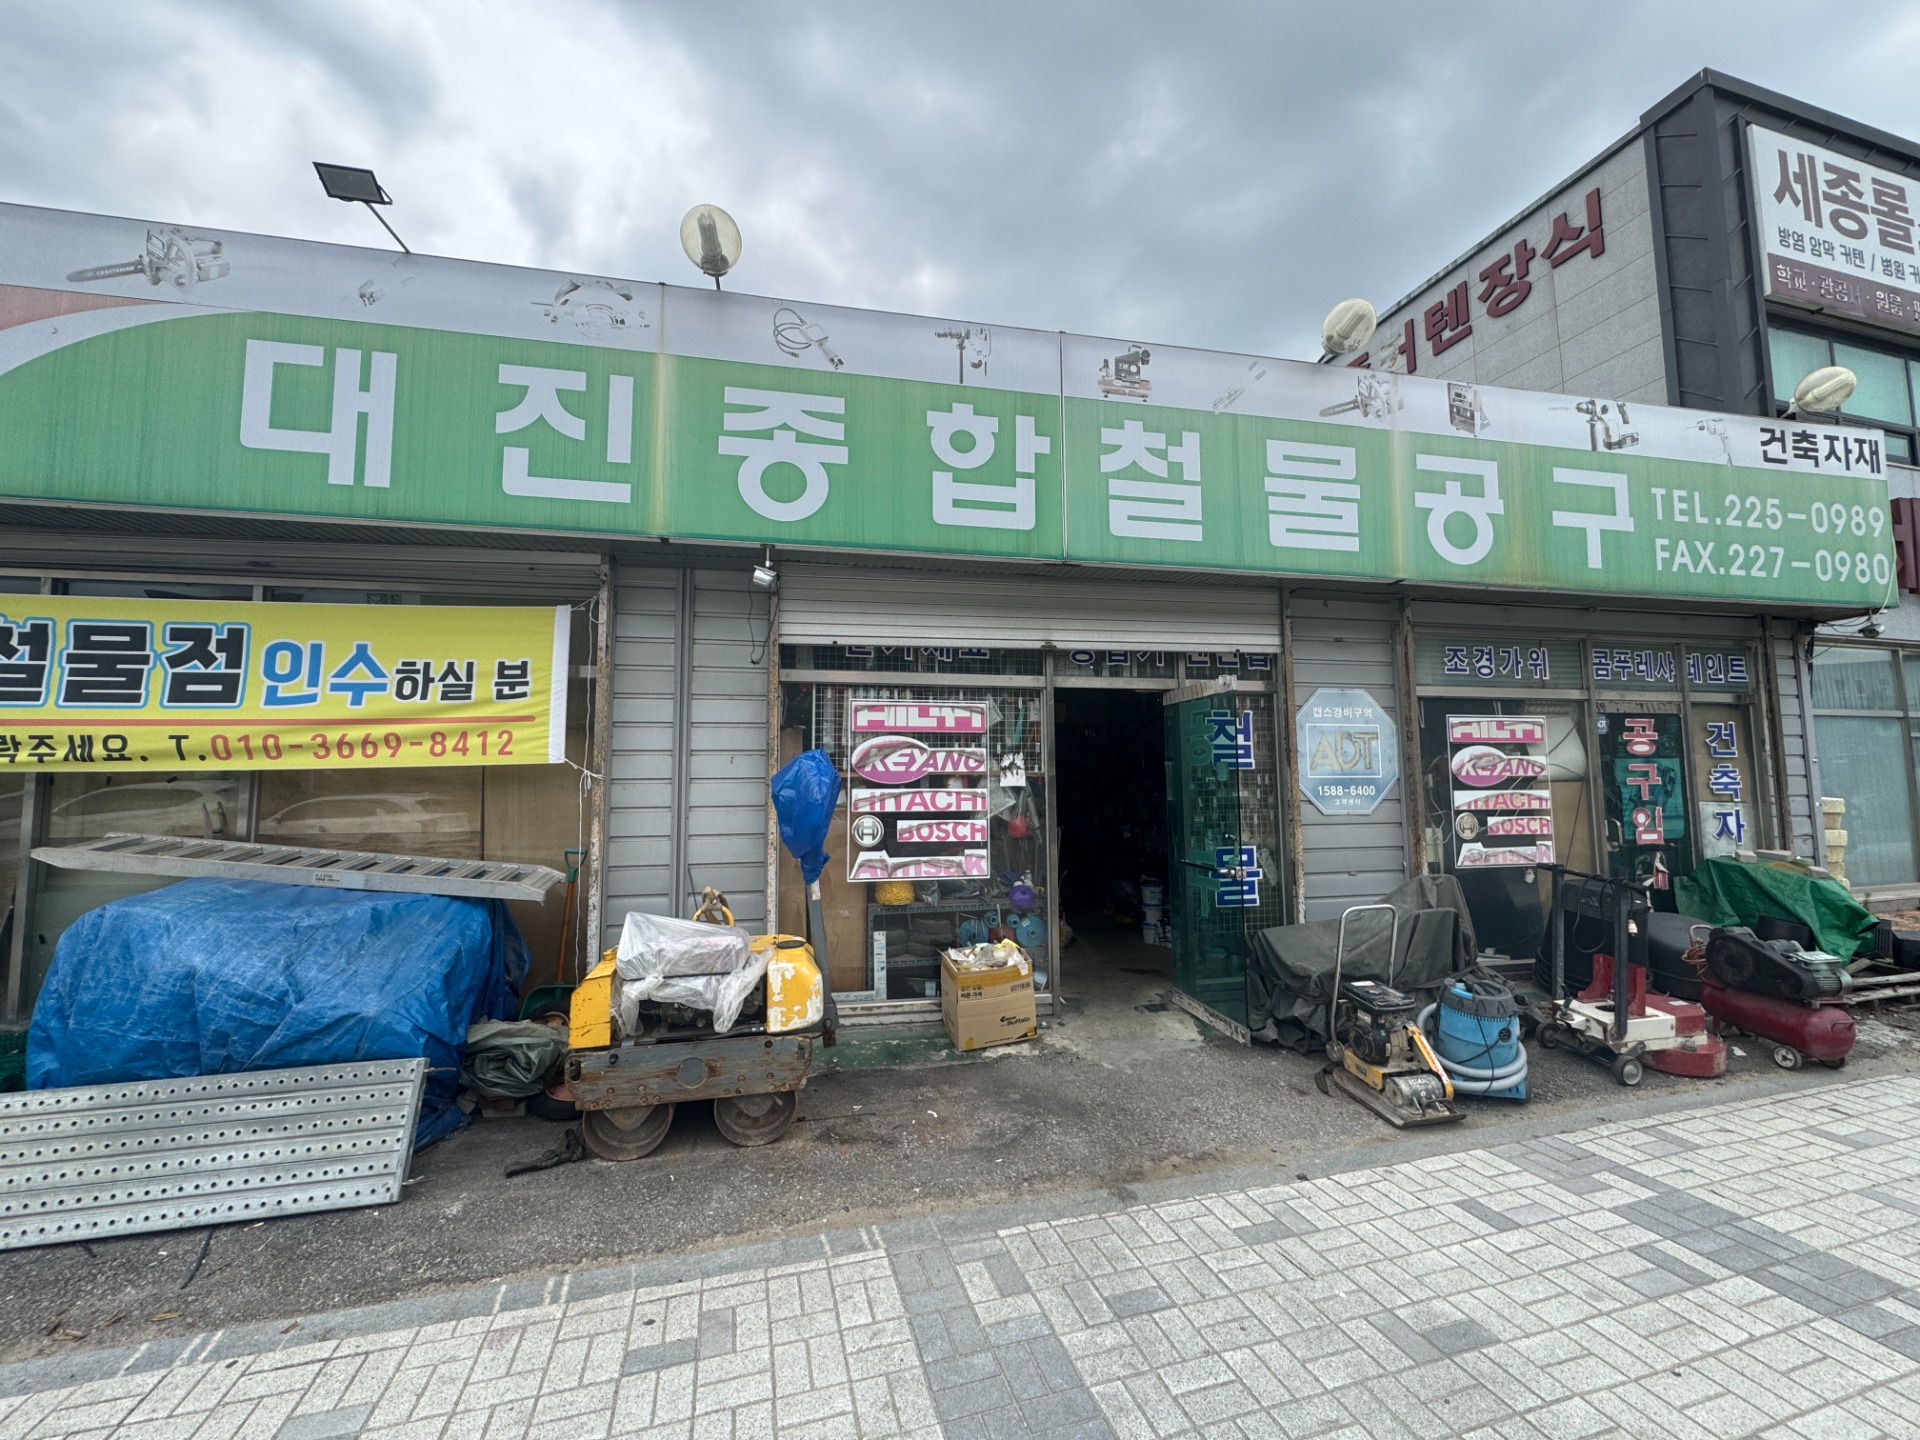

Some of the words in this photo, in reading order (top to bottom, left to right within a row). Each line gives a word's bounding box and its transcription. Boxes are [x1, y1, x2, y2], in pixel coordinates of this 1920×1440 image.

[1773, 149, 1920, 255] 세종롤
[1777, 226, 1805, 254] 방염
[1809, 235, 1836, 261] 암막
[1881, 256, 1906, 281] 병원
[1759, 427, 1882, 475] 건축자재
[494, 659, 531, 702] 분
[1444, 645, 1551, 680] 조경가위
[856, 706, 982, 728] HILTI
[1313, 707, 1374, 719] 캡스경비구역
[1310, 730, 1379, 771] ADT
[1317, 785, 1376, 796] 1588-6400
